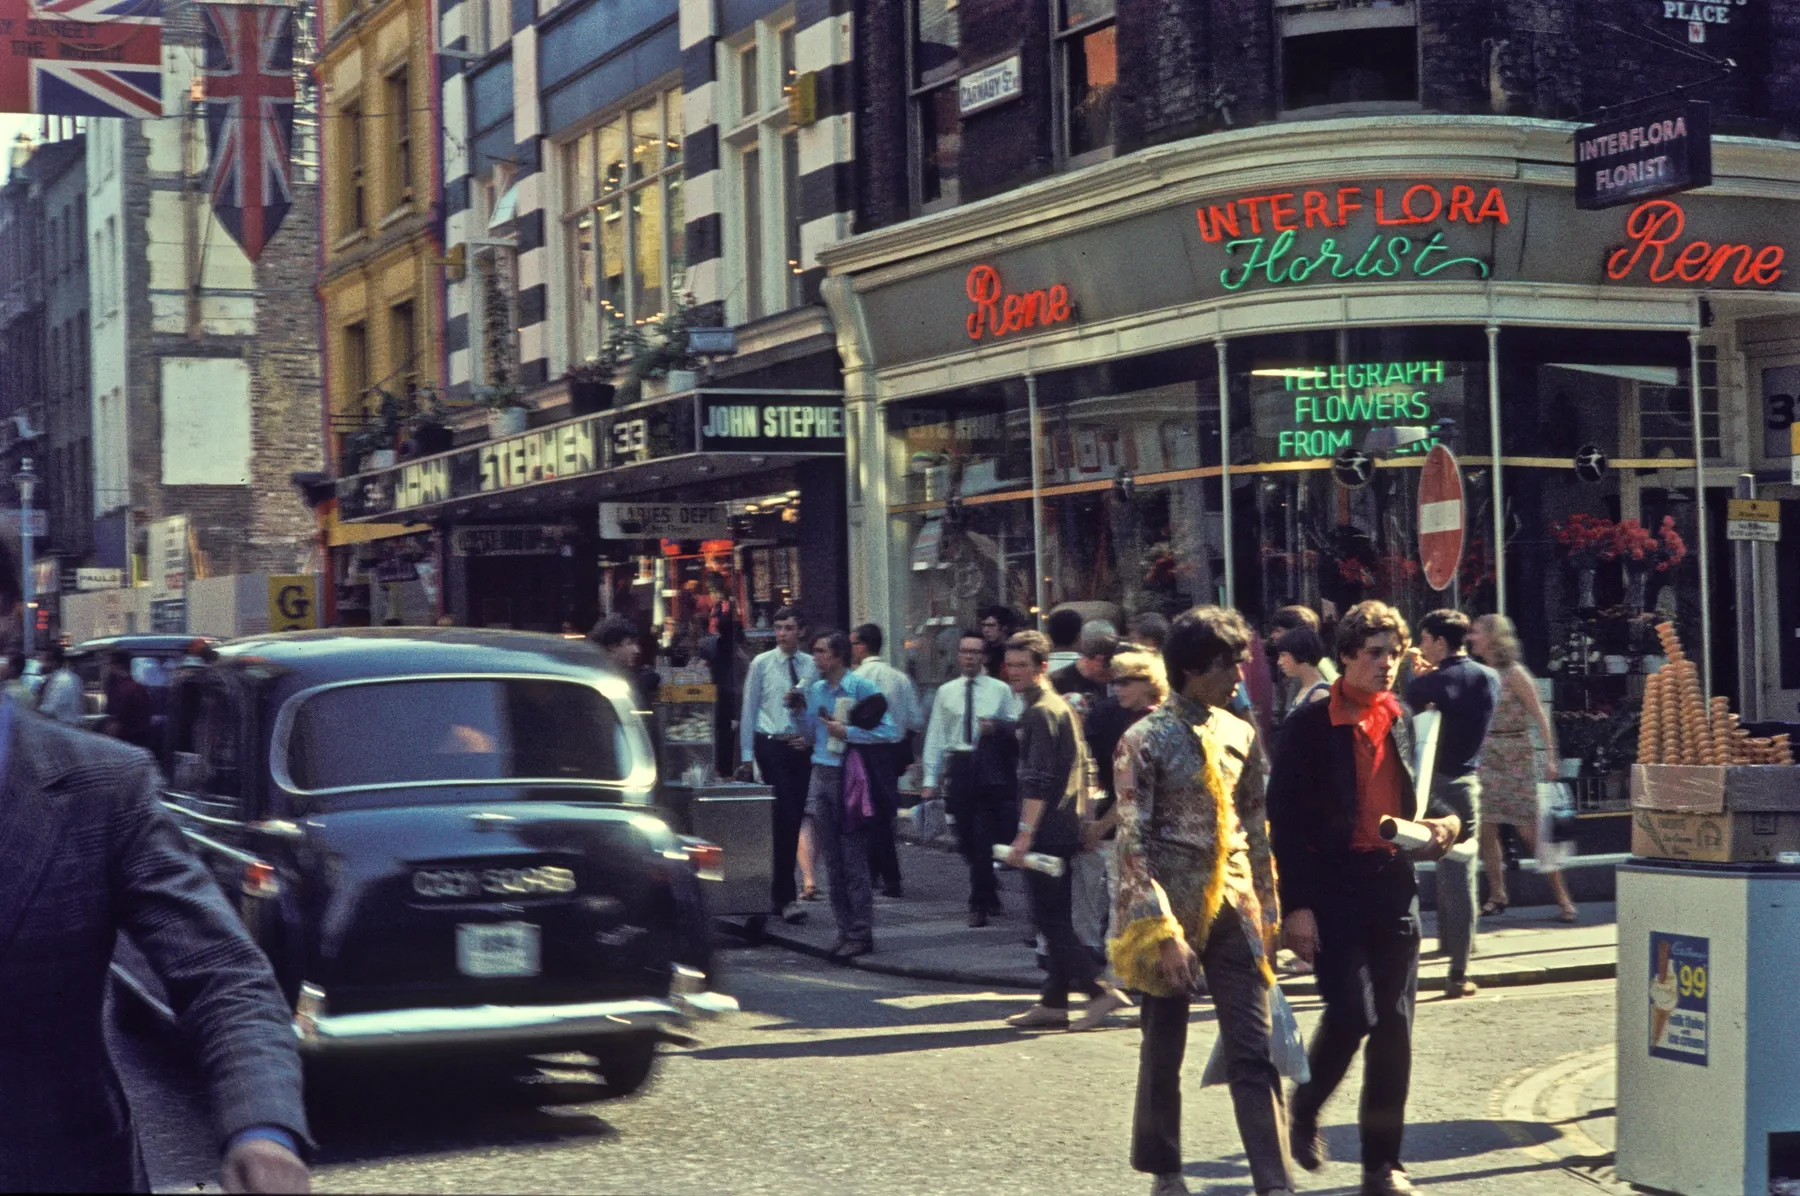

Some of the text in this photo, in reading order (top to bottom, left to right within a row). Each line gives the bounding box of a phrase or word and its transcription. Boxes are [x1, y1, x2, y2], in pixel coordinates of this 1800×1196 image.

[1663, 1, 1730, 24] PLACE
[1580, 117, 1687, 161] INTERFLORA
[1595, 156, 1668, 191] FLORIST
[1196, 184, 1509, 242] INTERFLORA
[1608, 200, 1784, 285] Rene
[966, 264, 1070, 339] Rene
[703, 406, 759, 437] JOHN
[1295, 392, 1430, 423] FLOWERS
[479, 418, 596, 492] STEPHEN
[614, 419, 647, 453] 33
[1279, 430, 1352, 457] FROM
